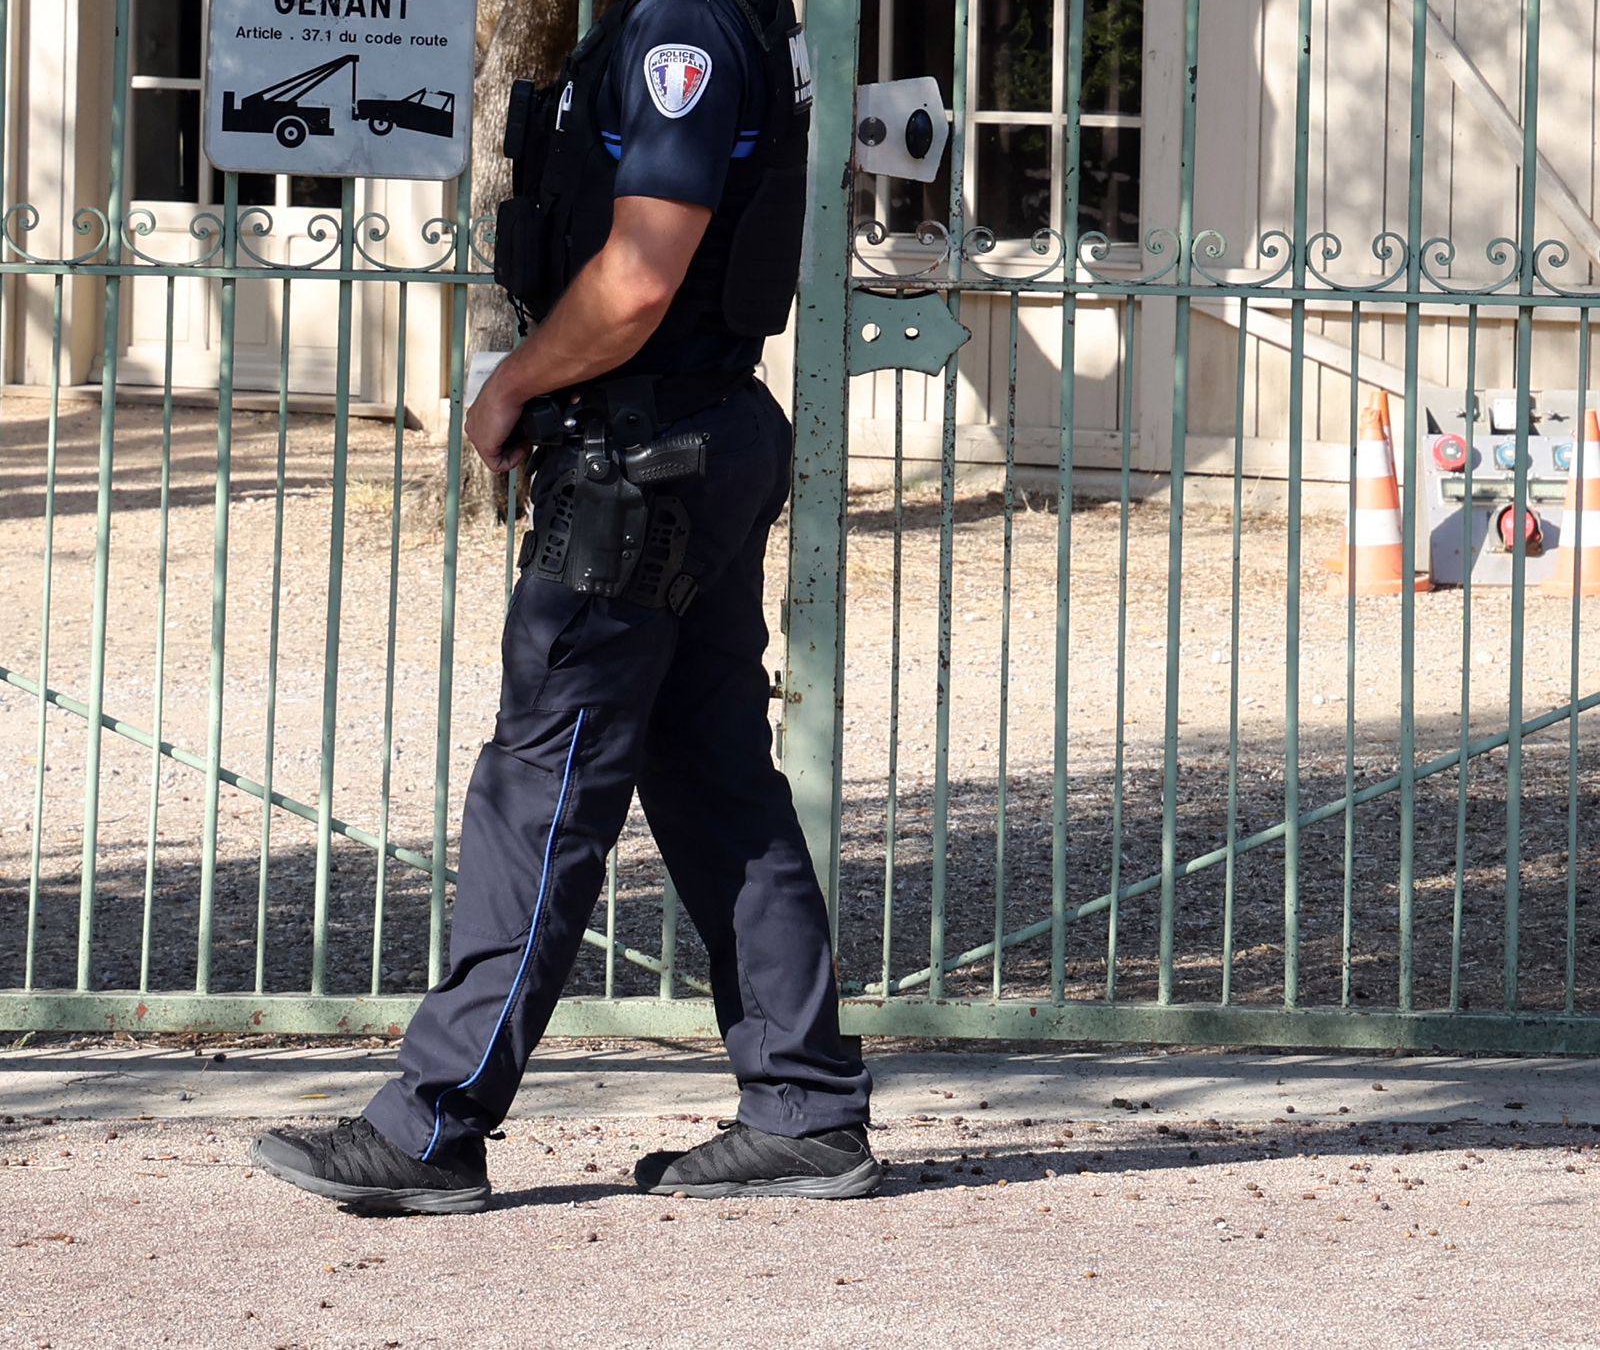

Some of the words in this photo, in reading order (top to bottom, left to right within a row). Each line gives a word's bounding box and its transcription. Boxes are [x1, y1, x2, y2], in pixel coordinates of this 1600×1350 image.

[235, 25, 283, 40] Article
[338, 29, 357, 44] du
[365, 31, 402, 45] code
[410, 35, 448, 47] route
[659, 51, 696, 61] POLICE
[651, 57, 704, 71] MUNICIPALE
